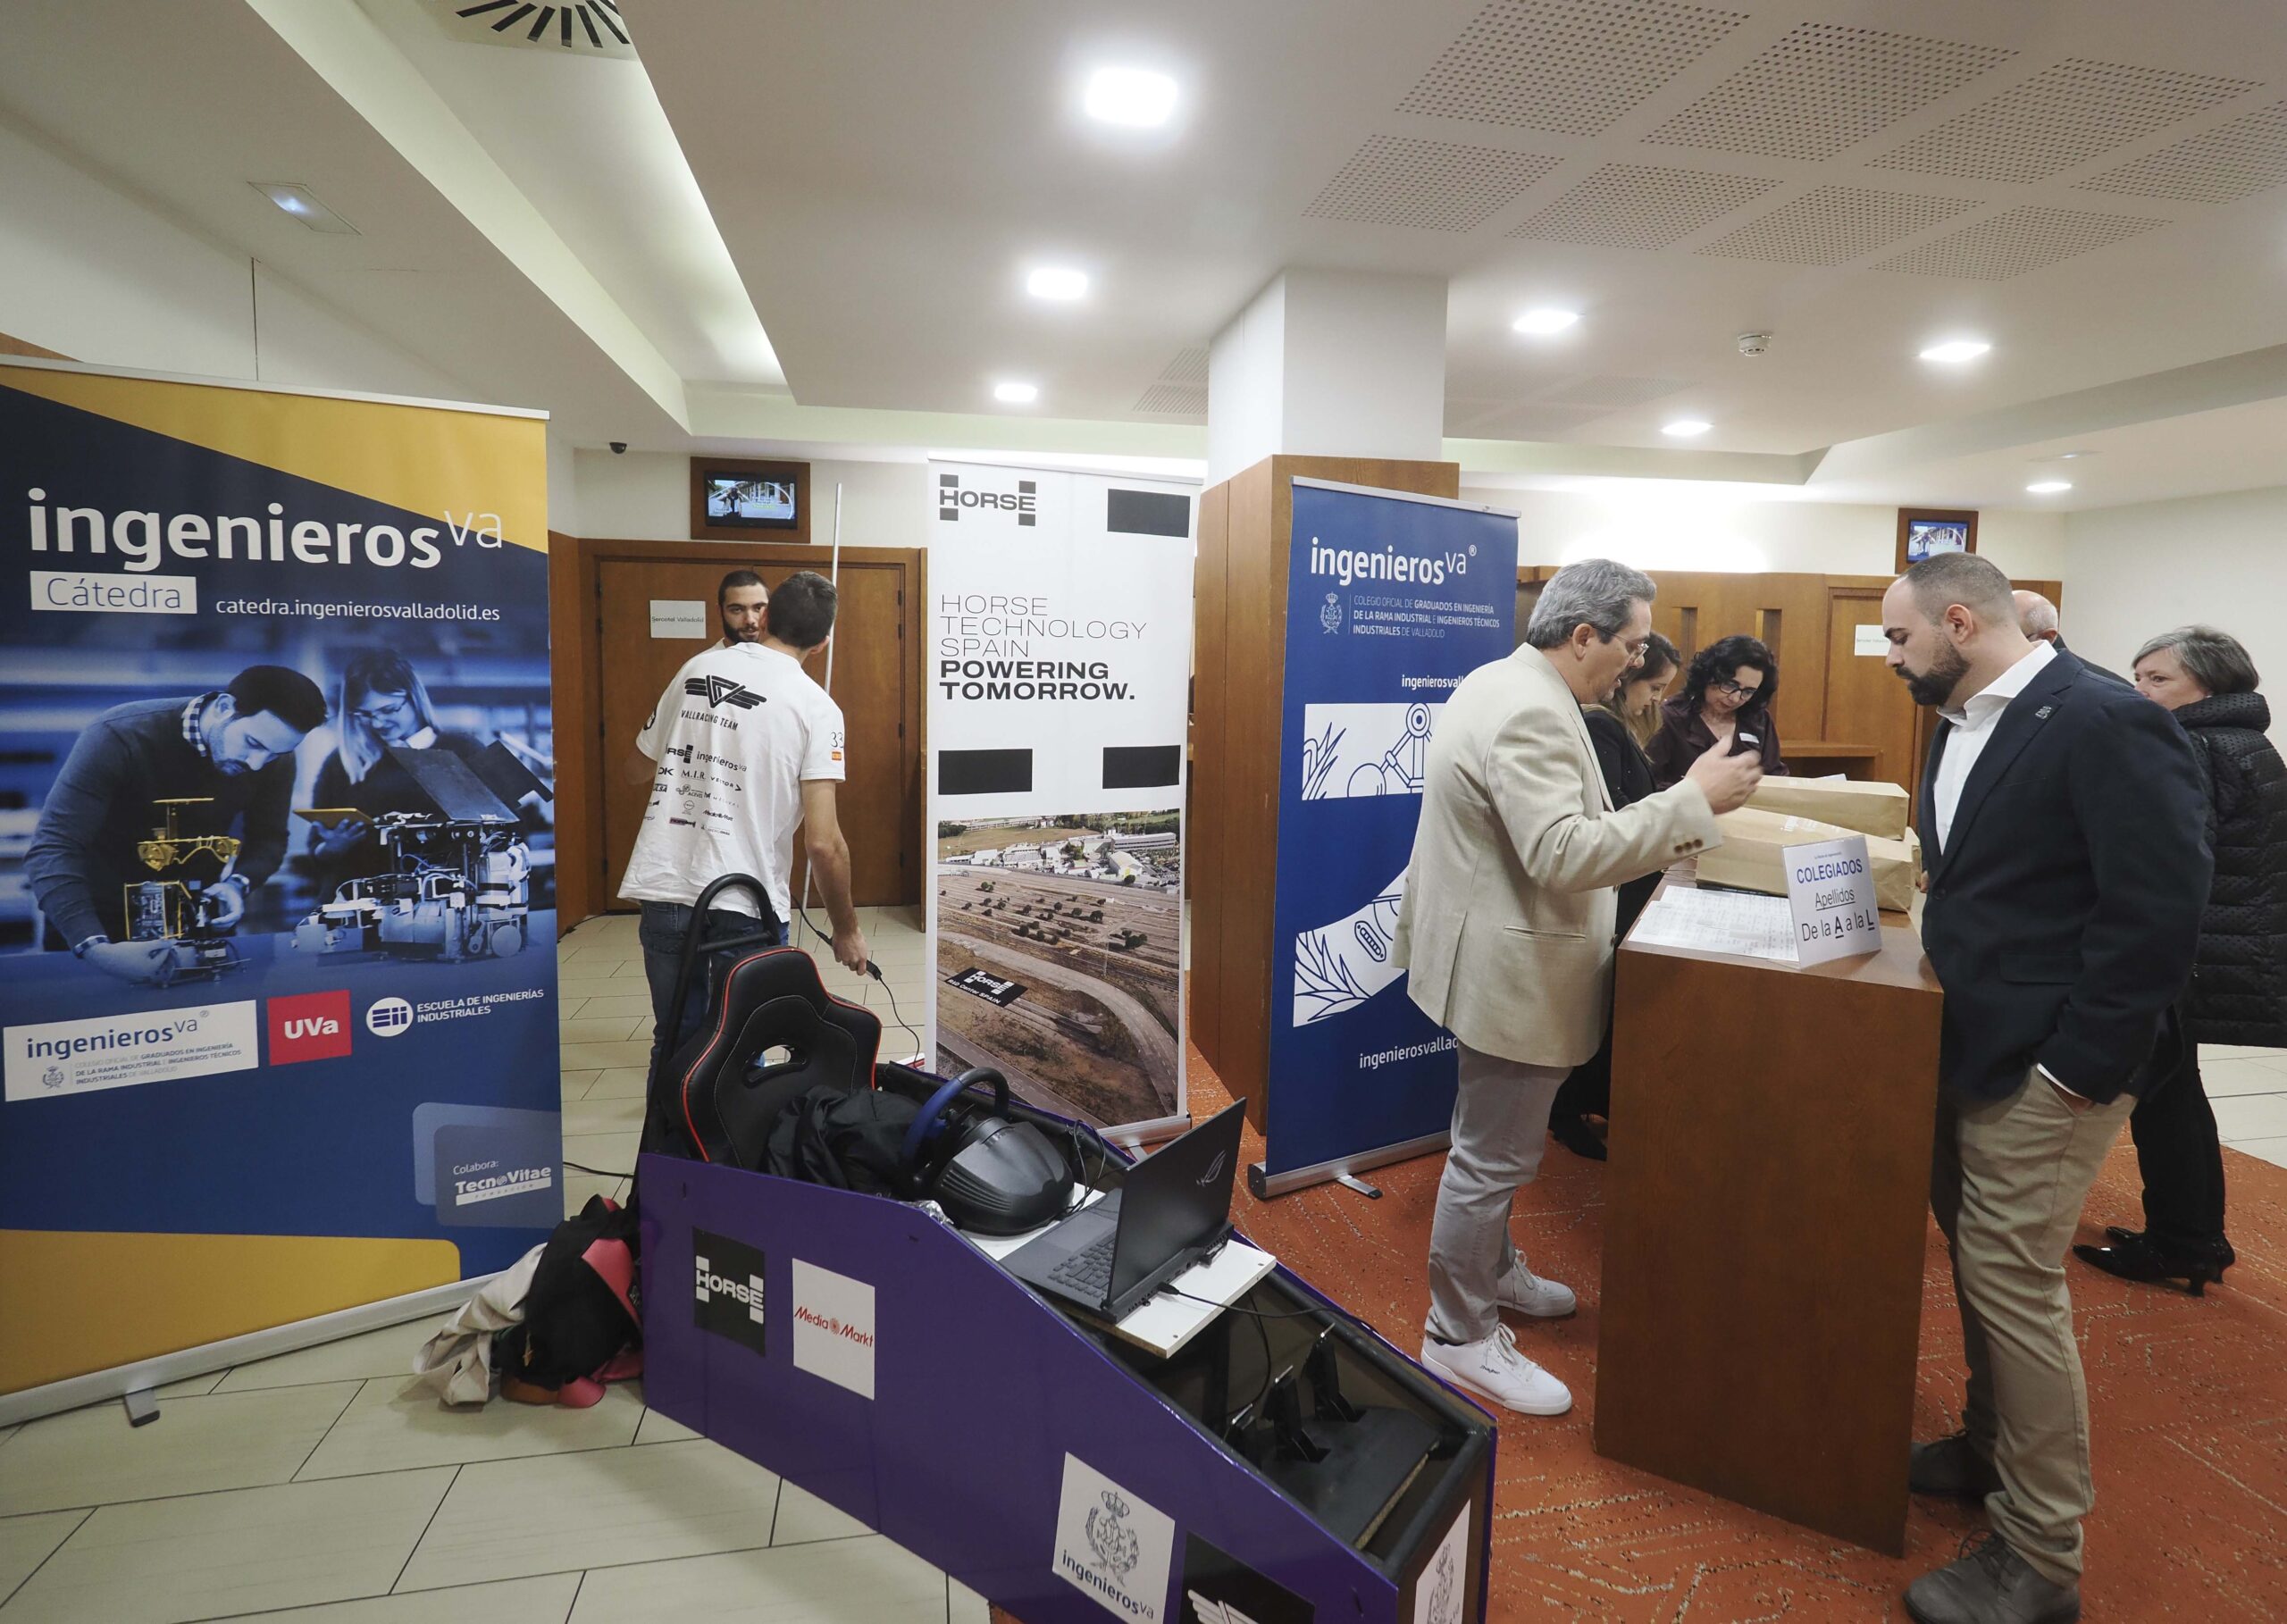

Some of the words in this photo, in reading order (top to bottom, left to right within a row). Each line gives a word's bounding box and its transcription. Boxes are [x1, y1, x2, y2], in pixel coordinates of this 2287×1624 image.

[46, 577, 181, 609] Cátedra
[216, 596, 500, 622] catedra.ingenierosvalladolid.es
[942, 594, 1048, 615] HORSE
[1354, 595, 1381, 607] COLEGIO
[1382, 597, 1403, 607] OFICIAL
[1405, 599, 1413, 608] DE
[1414, 599, 1453, 611] GRADUADOS
[1454, 602, 1462, 612] EN
[1463, 603, 1494, 614] INGENIERÍA
[940, 616, 1146, 639] TECHNOLOGY
[1353, 610, 1363, 620] DE
[1365, 611, 1374, 620] LA
[1375, 611, 1394, 621] RAMA
[1394, 613, 1432, 624] INDUSTRIAL
[1437, 615, 1473, 626] INGENIEROS
[1474, 616, 1500, 628] TÉCNICOS
[1353, 624, 1401, 636] INDUSTRIALES
[1402, 627, 1411, 637] DE
[1412, 627, 1445, 639] VALLADOLID
[941, 638, 1028, 657] SPAIN
[941, 660, 1109, 679] POWERING
[940, 682, 1135, 700] TOMORROW.
[681, 709, 718, 724] VALLRACING
[720, 717, 738, 731] TEAM
[1797, 858, 1863, 884] COLEGIADOS
[1815, 887, 1856, 909] Apellidos
[1801, 923, 1819, 942] De
[1821, 919, 1831, 937] la
[1835, 916, 1844, 935] A
[1845, 917, 1853, 932] a
[1854, 912, 1864, 929] la
[1865, 909, 1874, 926] L
[417, 999, 464, 1012] ESCUELA
[466, 996, 481, 1006] DE
[482, 989, 544, 1003] INGENIERÍAS
[959, 984, 979, 994] Center
[979, 992, 1001, 1004] SPAIN
[417, 1005, 490, 1023] INDUSTRIALES
[284, 1017, 339, 1039] UVa
[98, 1066, 118, 1074] RAMA
[121, 1060, 161, 1071] INDUSTRIAL
[168, 1054, 208, 1065] INGENIEROS
[210, 1049, 242, 1059] TÉCNICOS
[140, 1049, 184, 1060] GRADUADOS
[196, 1042, 233, 1053] INGENIERÍA
[76, 1072, 128, 1084] INDUSTRIALES
[453, 1160, 498, 1176] Colabora:
[696, 1269, 764, 1310] HORSE
[794, 1306, 829, 1330] Media
[840, 1324, 874, 1348] Markt
